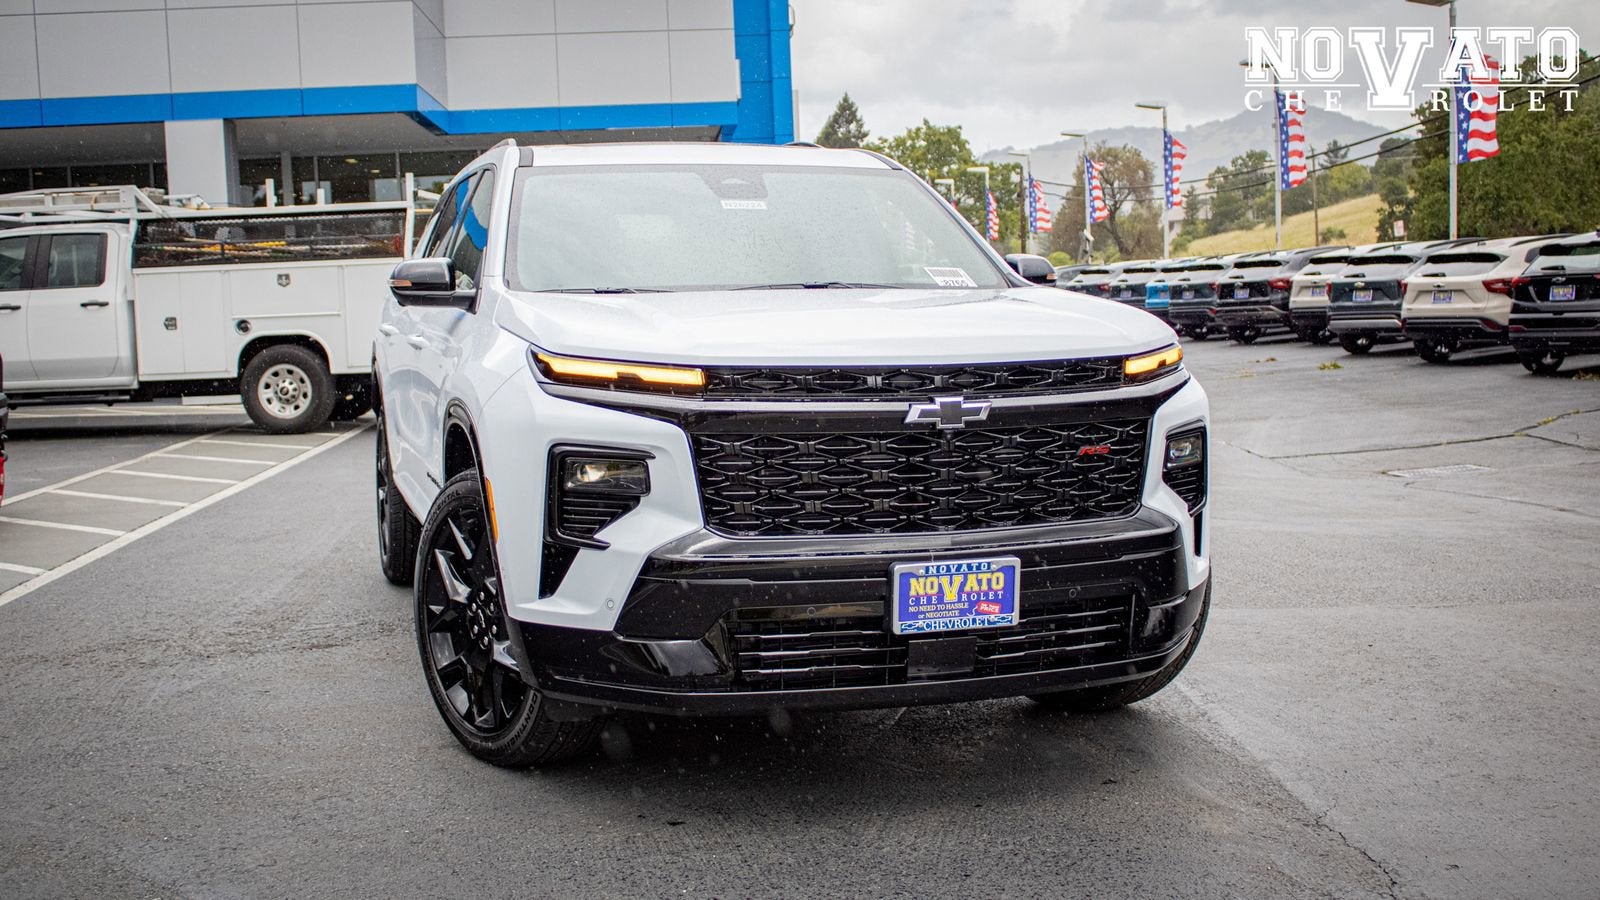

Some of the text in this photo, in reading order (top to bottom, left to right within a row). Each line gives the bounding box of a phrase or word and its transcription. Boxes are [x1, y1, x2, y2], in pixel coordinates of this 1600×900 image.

[1077, 444, 1111, 456] RS
[929, 563, 988, 574] NOVATO
[909, 572, 1004, 602] NOVATO
[946, 602, 969, 610] HASSLE
[926, 610, 960, 618] NEGOTIATE
[923, 618, 989, 631] CHEVROLET
